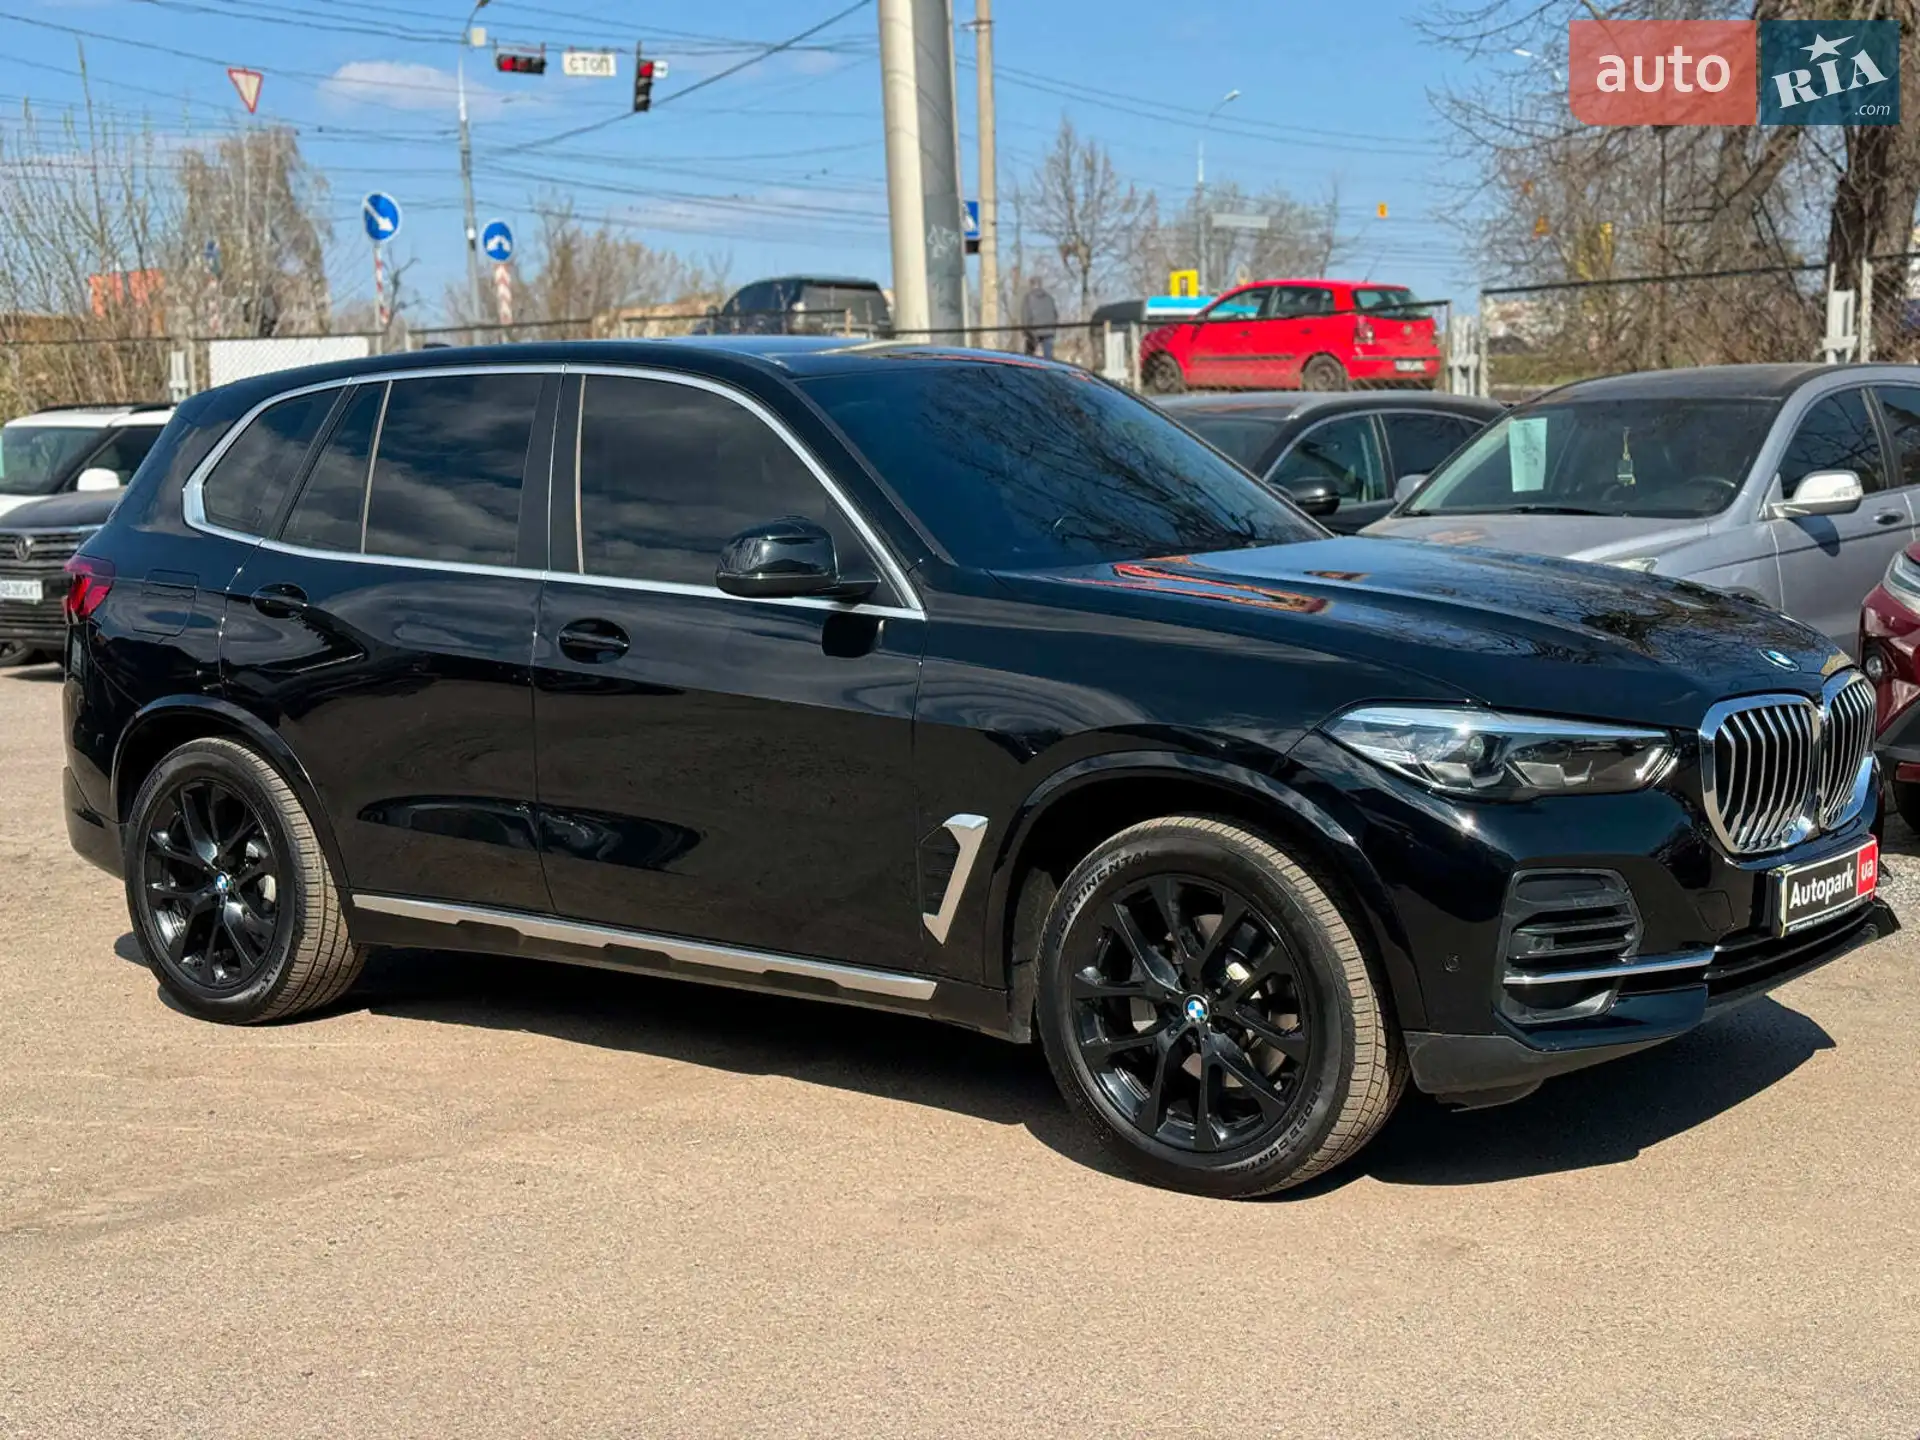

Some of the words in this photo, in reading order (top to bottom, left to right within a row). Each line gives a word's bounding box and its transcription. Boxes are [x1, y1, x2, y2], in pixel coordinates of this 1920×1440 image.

[568, 55, 610, 73] СТОП
[1789, 862, 1854, 909] Autopark
[1861, 859, 1874, 881] ua
